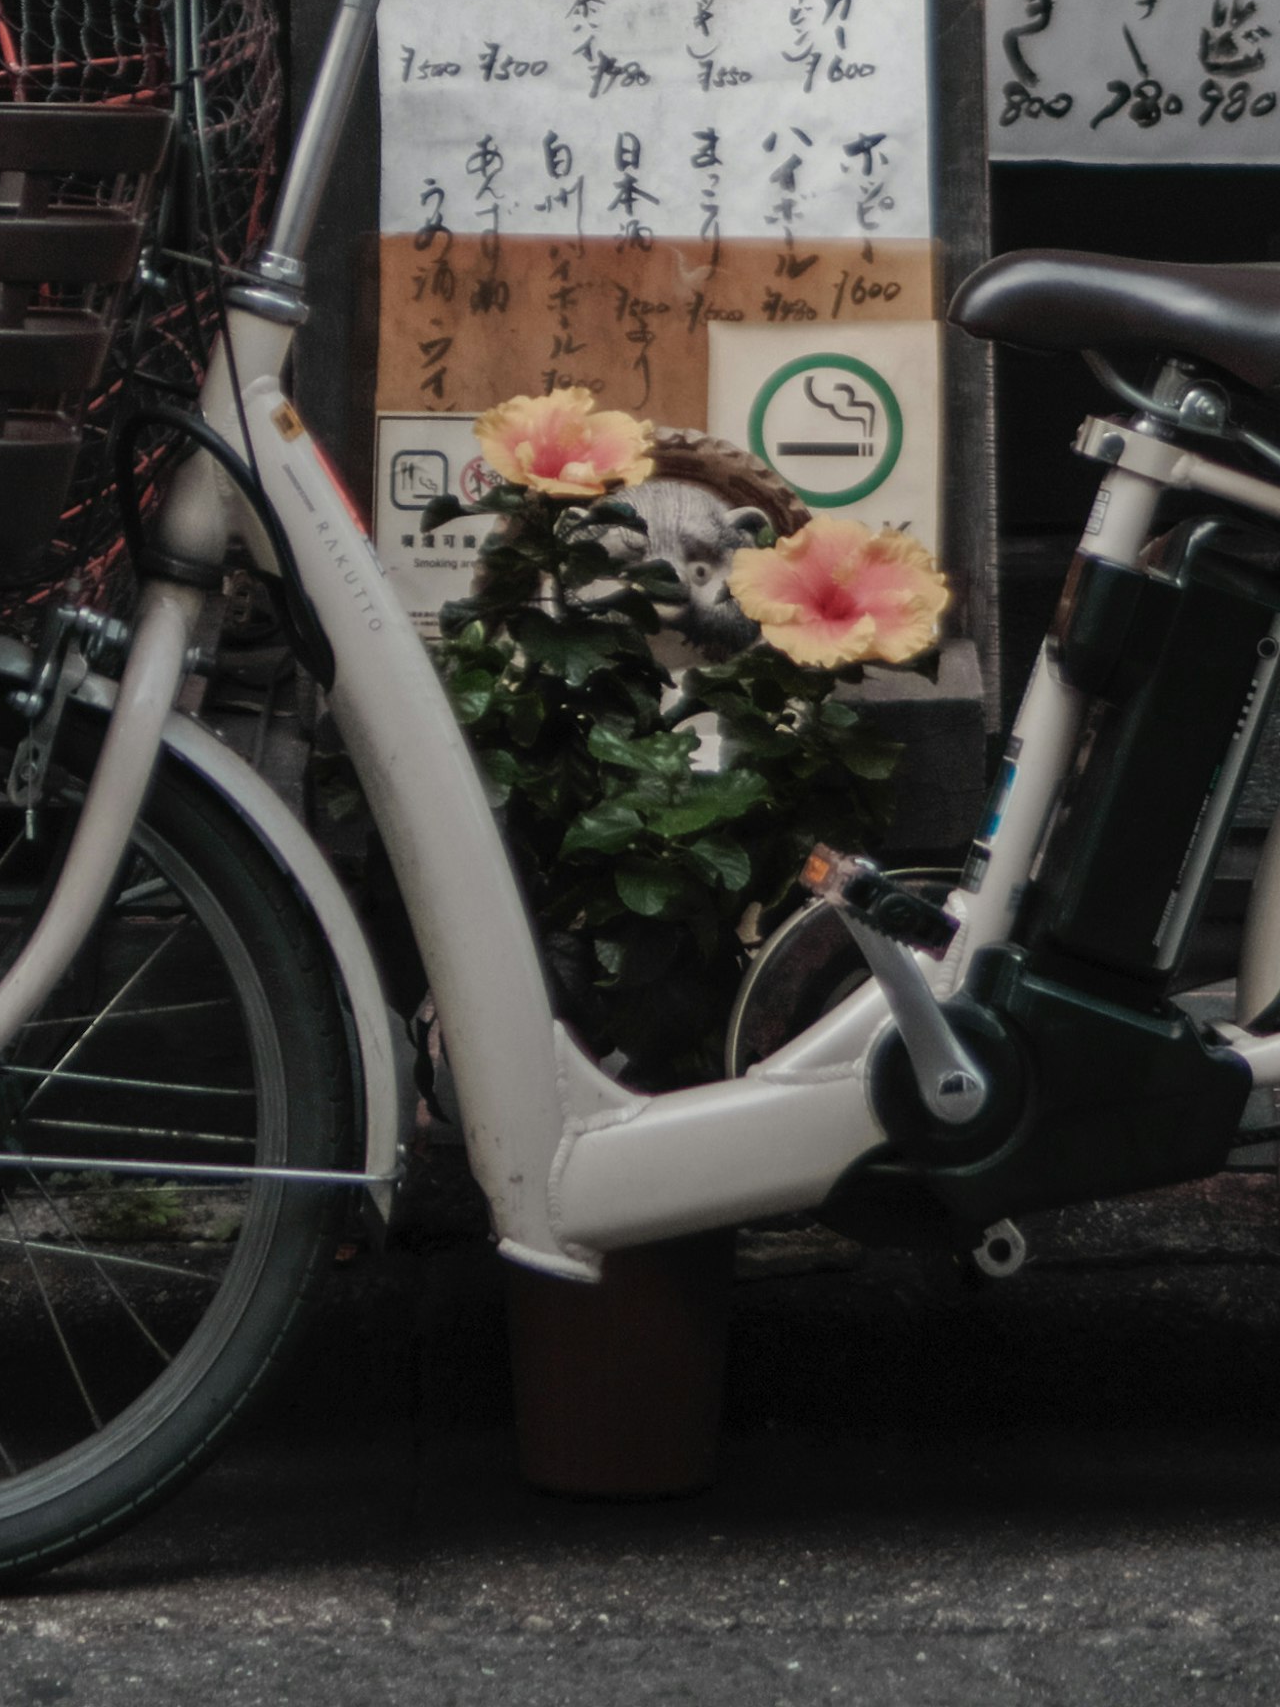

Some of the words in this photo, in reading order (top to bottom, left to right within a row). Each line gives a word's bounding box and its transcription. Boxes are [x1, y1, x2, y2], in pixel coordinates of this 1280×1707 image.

[1000, 81, 1074, 128] 800
[1090, 78, 1183, 131] 780
[1198, 78, 1278, 127] 980
[608, 131, 660, 254] 日本酒
[690, 127, 723, 281] まっこり
[762, 126, 819, 279] ハイボール
[840, 132, 896, 264] ホッピー
[316, 521, 383, 632] RAKUTTO
[414, 558, 458, 571] Smoking
